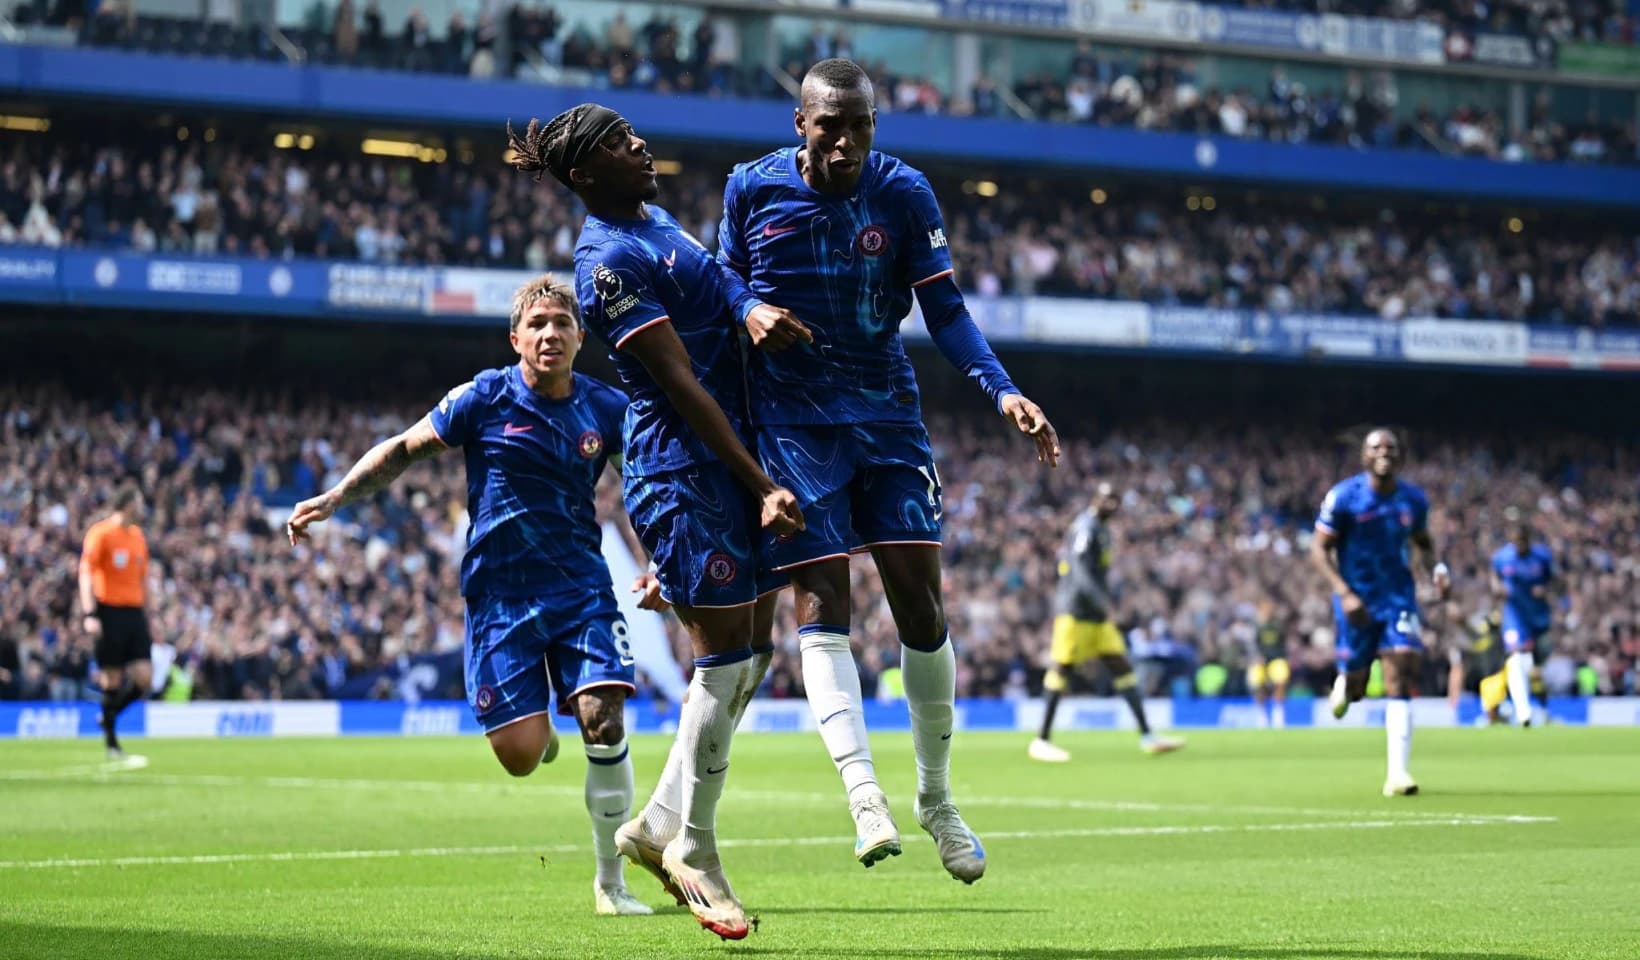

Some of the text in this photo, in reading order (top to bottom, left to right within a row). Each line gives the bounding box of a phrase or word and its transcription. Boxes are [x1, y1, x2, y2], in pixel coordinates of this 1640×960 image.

[605, 294, 634, 314] No room
[607, 297, 640, 320] for racism
[611, 620, 634, 666] 8
